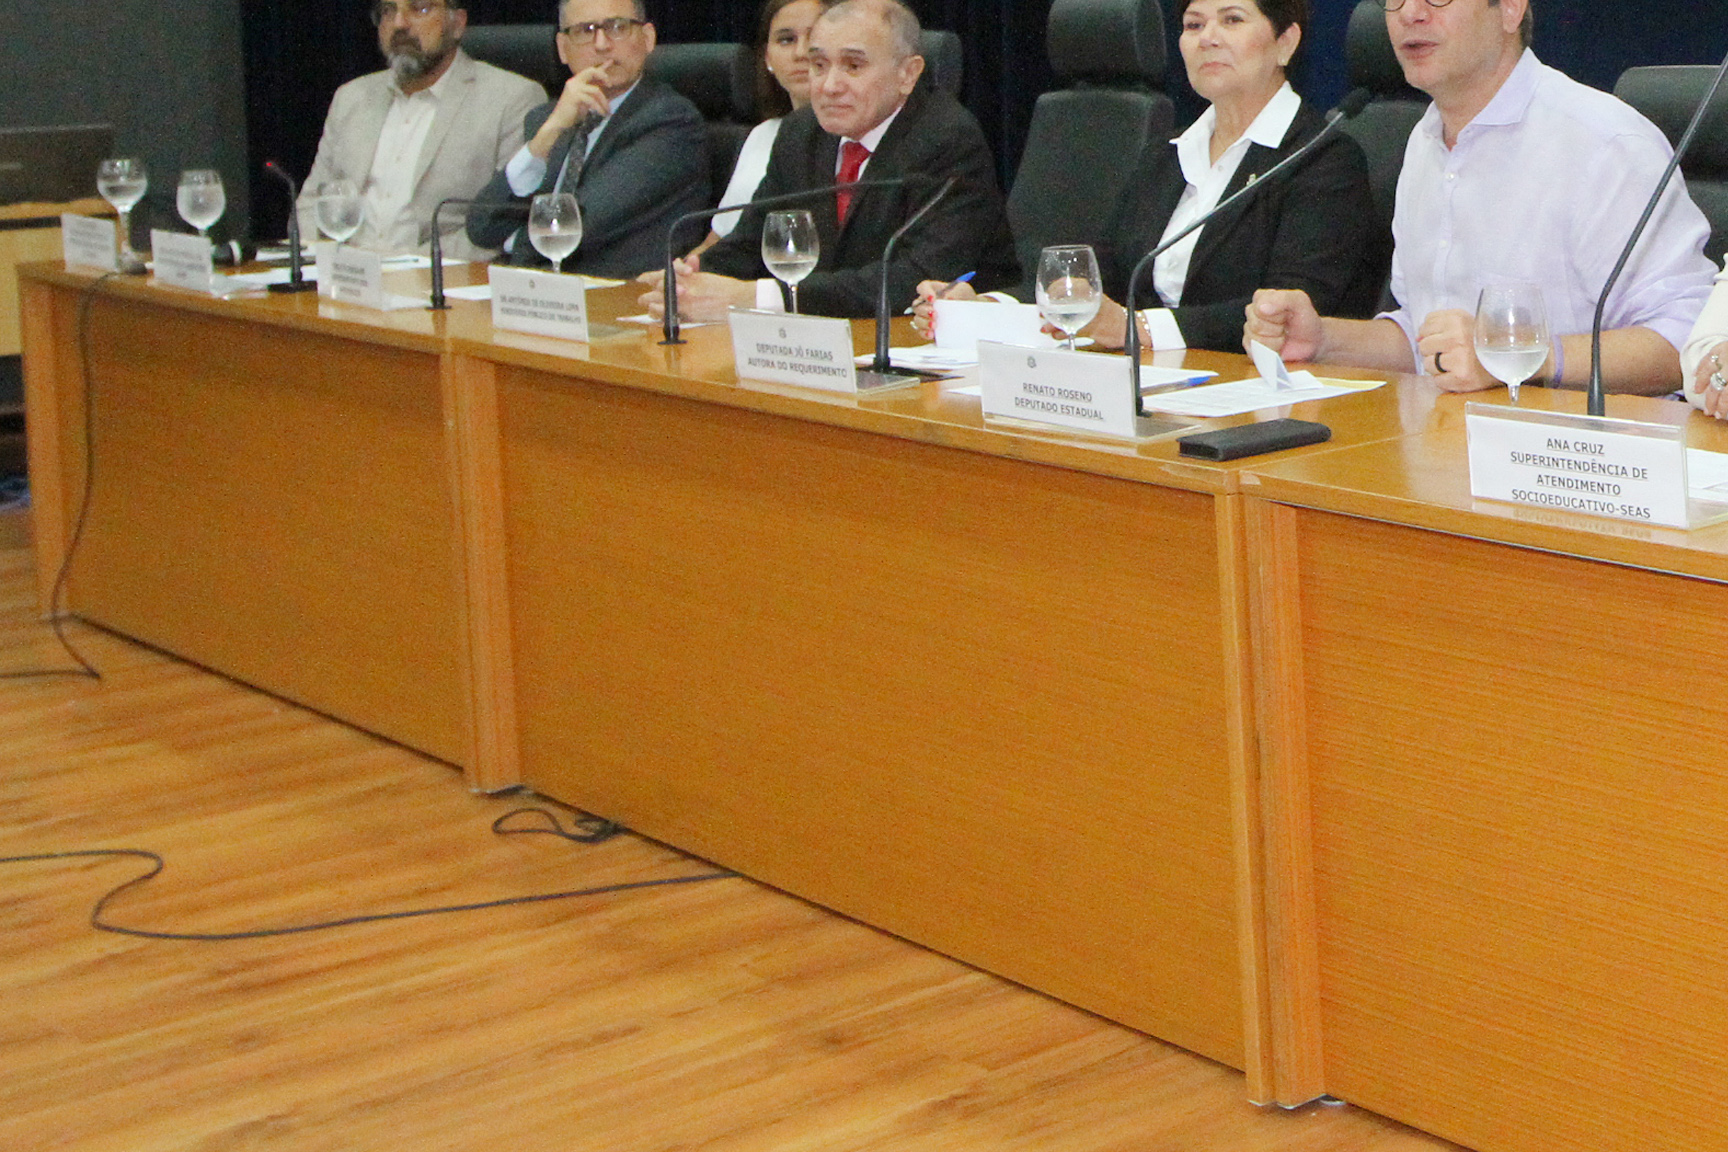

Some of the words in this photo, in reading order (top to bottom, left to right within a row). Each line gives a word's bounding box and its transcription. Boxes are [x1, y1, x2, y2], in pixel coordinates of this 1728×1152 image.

[756, 344, 792, 358] DEPUTADA
[805, 348, 833, 361] FARIAS
[748, 357, 775, 370] AUTORA
[777, 360, 788, 370] DO
[789, 361, 847, 379] REQUERIMENTO
[1022, 383, 1055, 398] RENATO
[1058, 387, 1093, 402] ROSENO
[1015, 397, 1058, 413] DEPUTADO
[1060, 403, 1104, 421] ESTADUAL
[1546, 438, 1571, 451] ANA
[1573, 441, 1605, 456] CRUZ
[1510, 451, 1628, 477] SUPERINTENDÊNCIA
[1632, 467, 1648, 479] DE
[1536, 474, 1621, 496] ATENDIMENTO
[1511, 489, 1651, 519] SOCIOEDUCATIVO-SEAS
